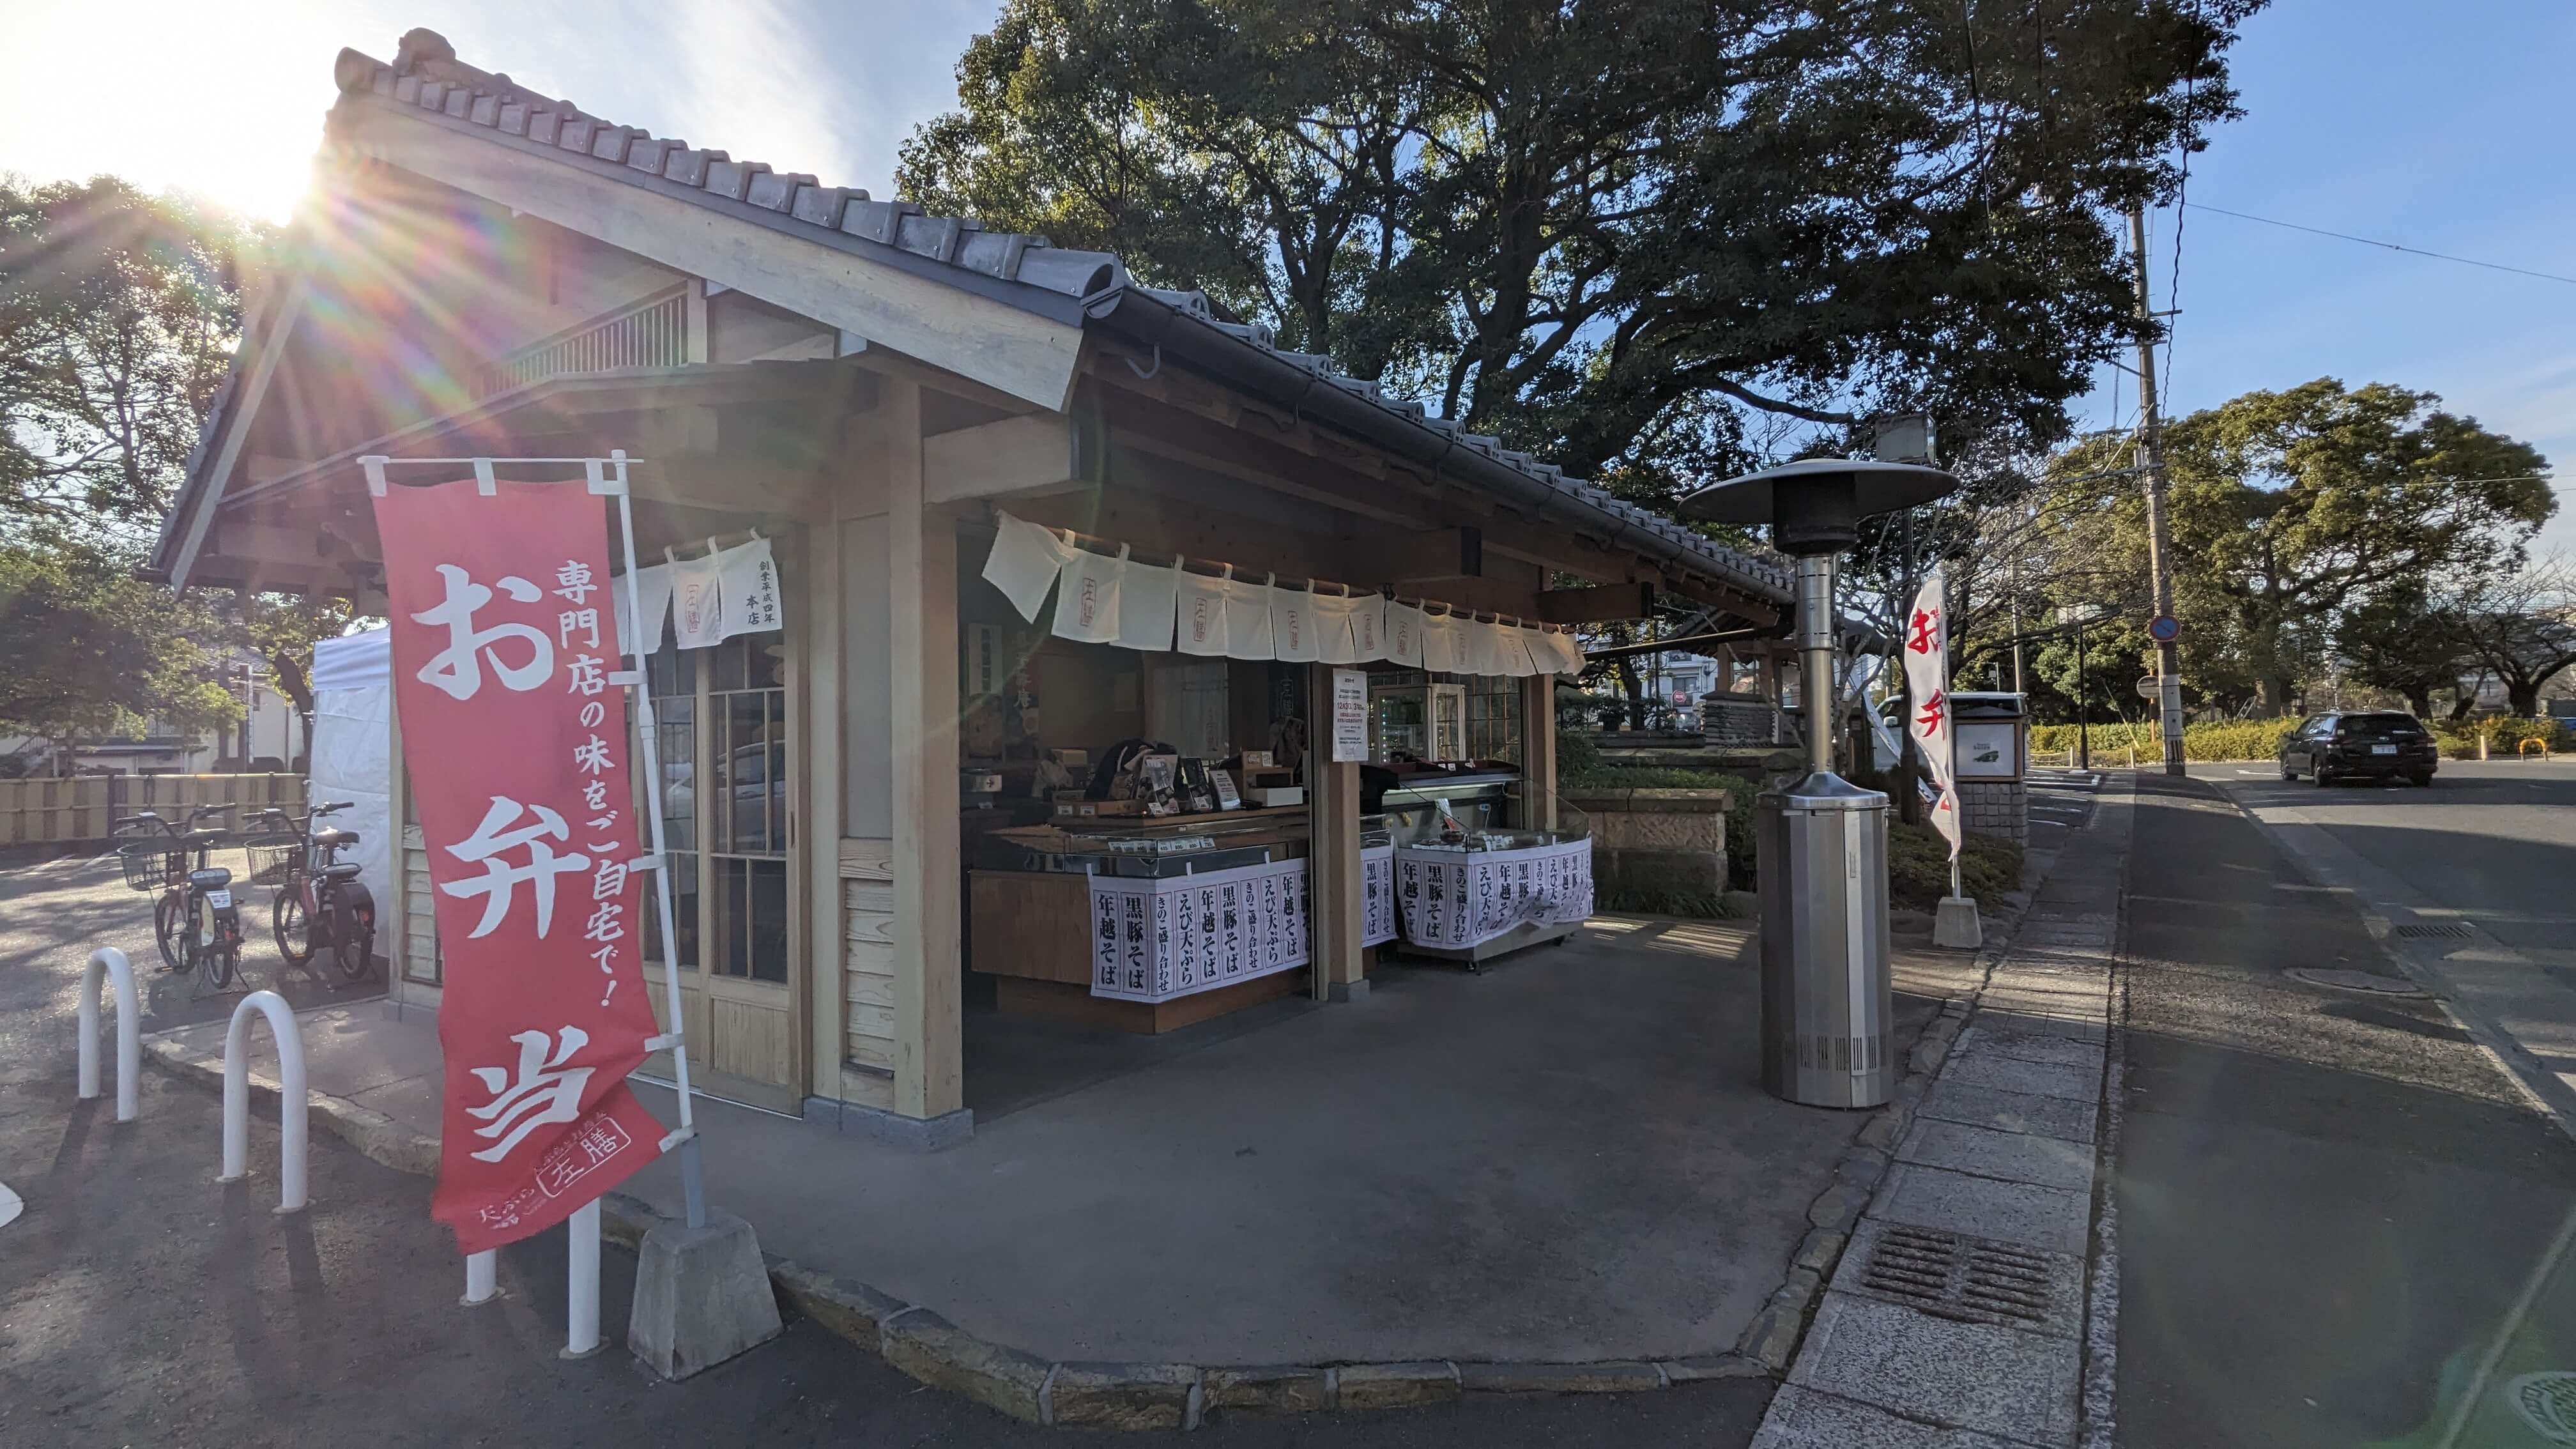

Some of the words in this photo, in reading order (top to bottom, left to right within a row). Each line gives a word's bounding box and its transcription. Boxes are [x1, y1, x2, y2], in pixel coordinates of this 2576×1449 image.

[746, 595, 760, 625] 本店
[759, 561, 775, 623] 創業平成四年
[411, 565, 596, 1162] お弁当
[1367, 862, 1377, 935] 黒豚そば
[1402, 862, 1419, 935] 年越そば
[1425, 865, 1443, 937] 黒豚そば
[1453, 866, 1466, 942] きのこ盛り合わせ
[1099, 894, 1116, 985] 年越そば
[1126, 896, 1144, 989] 黒豚そば
[1157, 897, 1169, 991] きのこ盛り合わせ
[1179, 894, 1194, 985] えび天ぷら
[1201, 890, 1216, 978] 年越そば
[1223, 885, 1238, 974] 黒豚そば
[1246, 882, 1258, 968] きのこ盛り合わせ
[1265, 880, 1278, 963] えび天ぷら
[1282, 876, 1298, 956] 年越そば
[551, 1128, 618, 1186] 左膳
